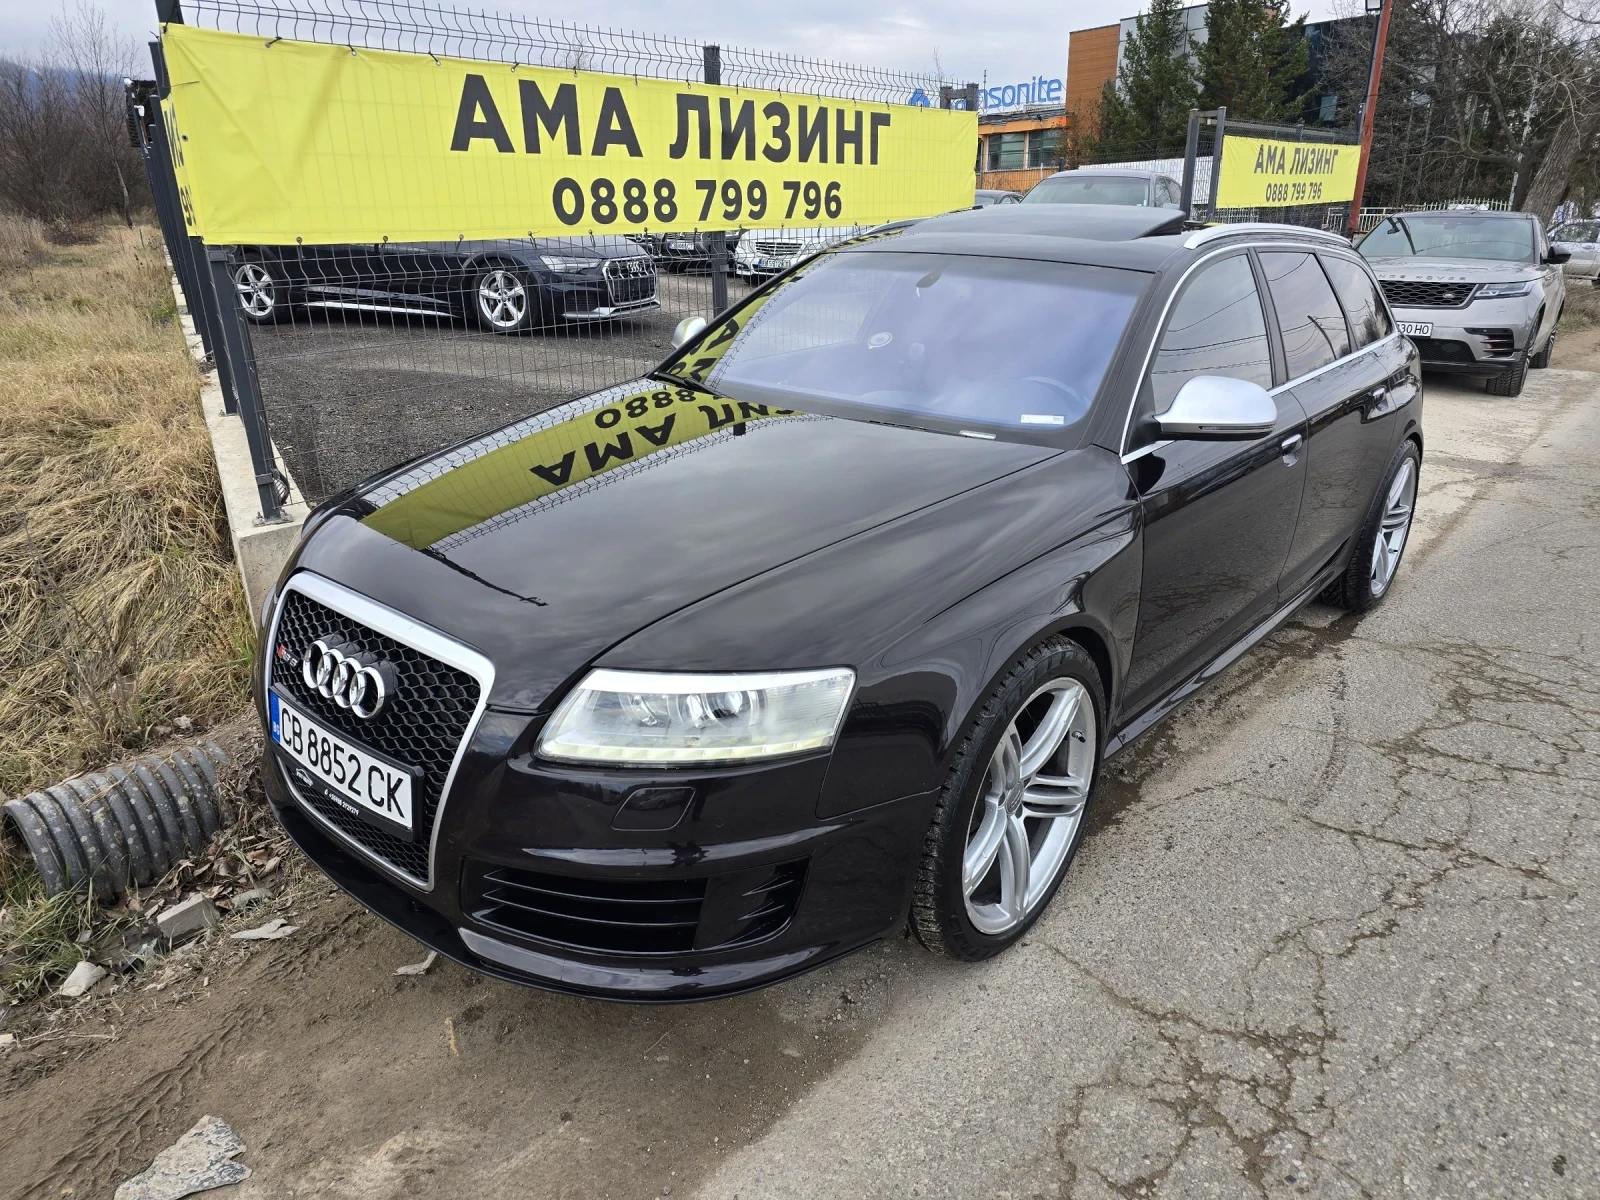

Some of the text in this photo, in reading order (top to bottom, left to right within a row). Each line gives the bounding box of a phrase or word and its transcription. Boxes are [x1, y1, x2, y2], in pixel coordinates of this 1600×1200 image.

[450, 73, 892, 166] АМА ЛИЗИНГ
[1254, 144, 1339, 175] АМА ЛИЗИНГ
[552, 177, 843, 226] 0888 799 796
[1265, 181, 1323, 203] 0888 799 796
[281, 707, 304, 756] CB
[307, 728, 362, 797] 8852
[367, 765, 405, 819] CK
